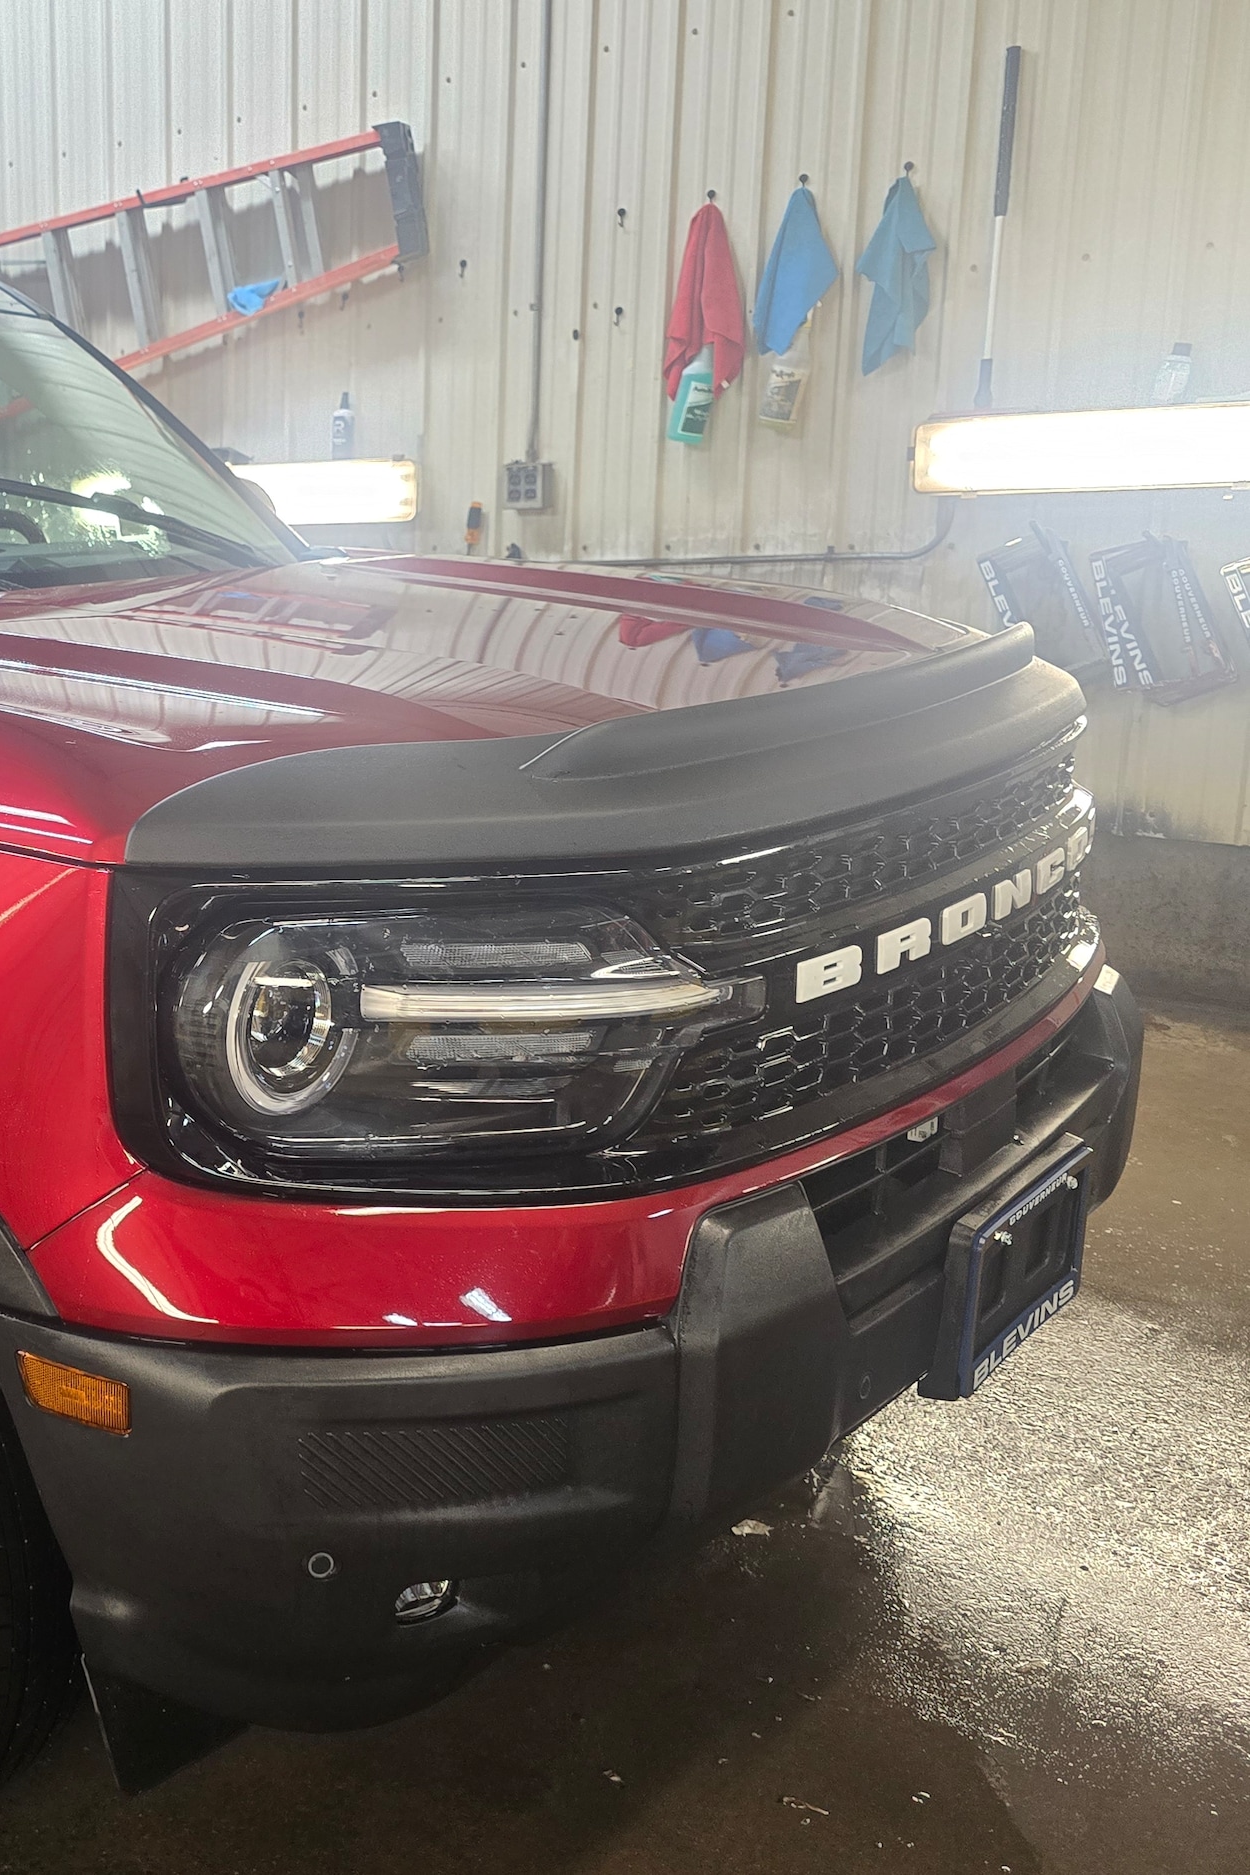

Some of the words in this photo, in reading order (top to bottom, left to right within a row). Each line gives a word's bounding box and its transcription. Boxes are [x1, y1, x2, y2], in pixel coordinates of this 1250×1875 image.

[980, 560, 1015, 627] BLEV
[1058, 559, 1089, 627] GOUVERNEUR
[1092, 560, 1127, 686] BLEVINS
[1171, 570, 1191, 643] GOUVERNEUR
[1178, 569, 1212, 638] GOUVERNEUR
[1109, 578, 1154, 690] EVINS
[796, 826, 1089, 1004] BRONCO
[1009, 1172, 1068, 1225] GOUVERNEUR
[973, 1279, 1075, 1390] BLEVINS
